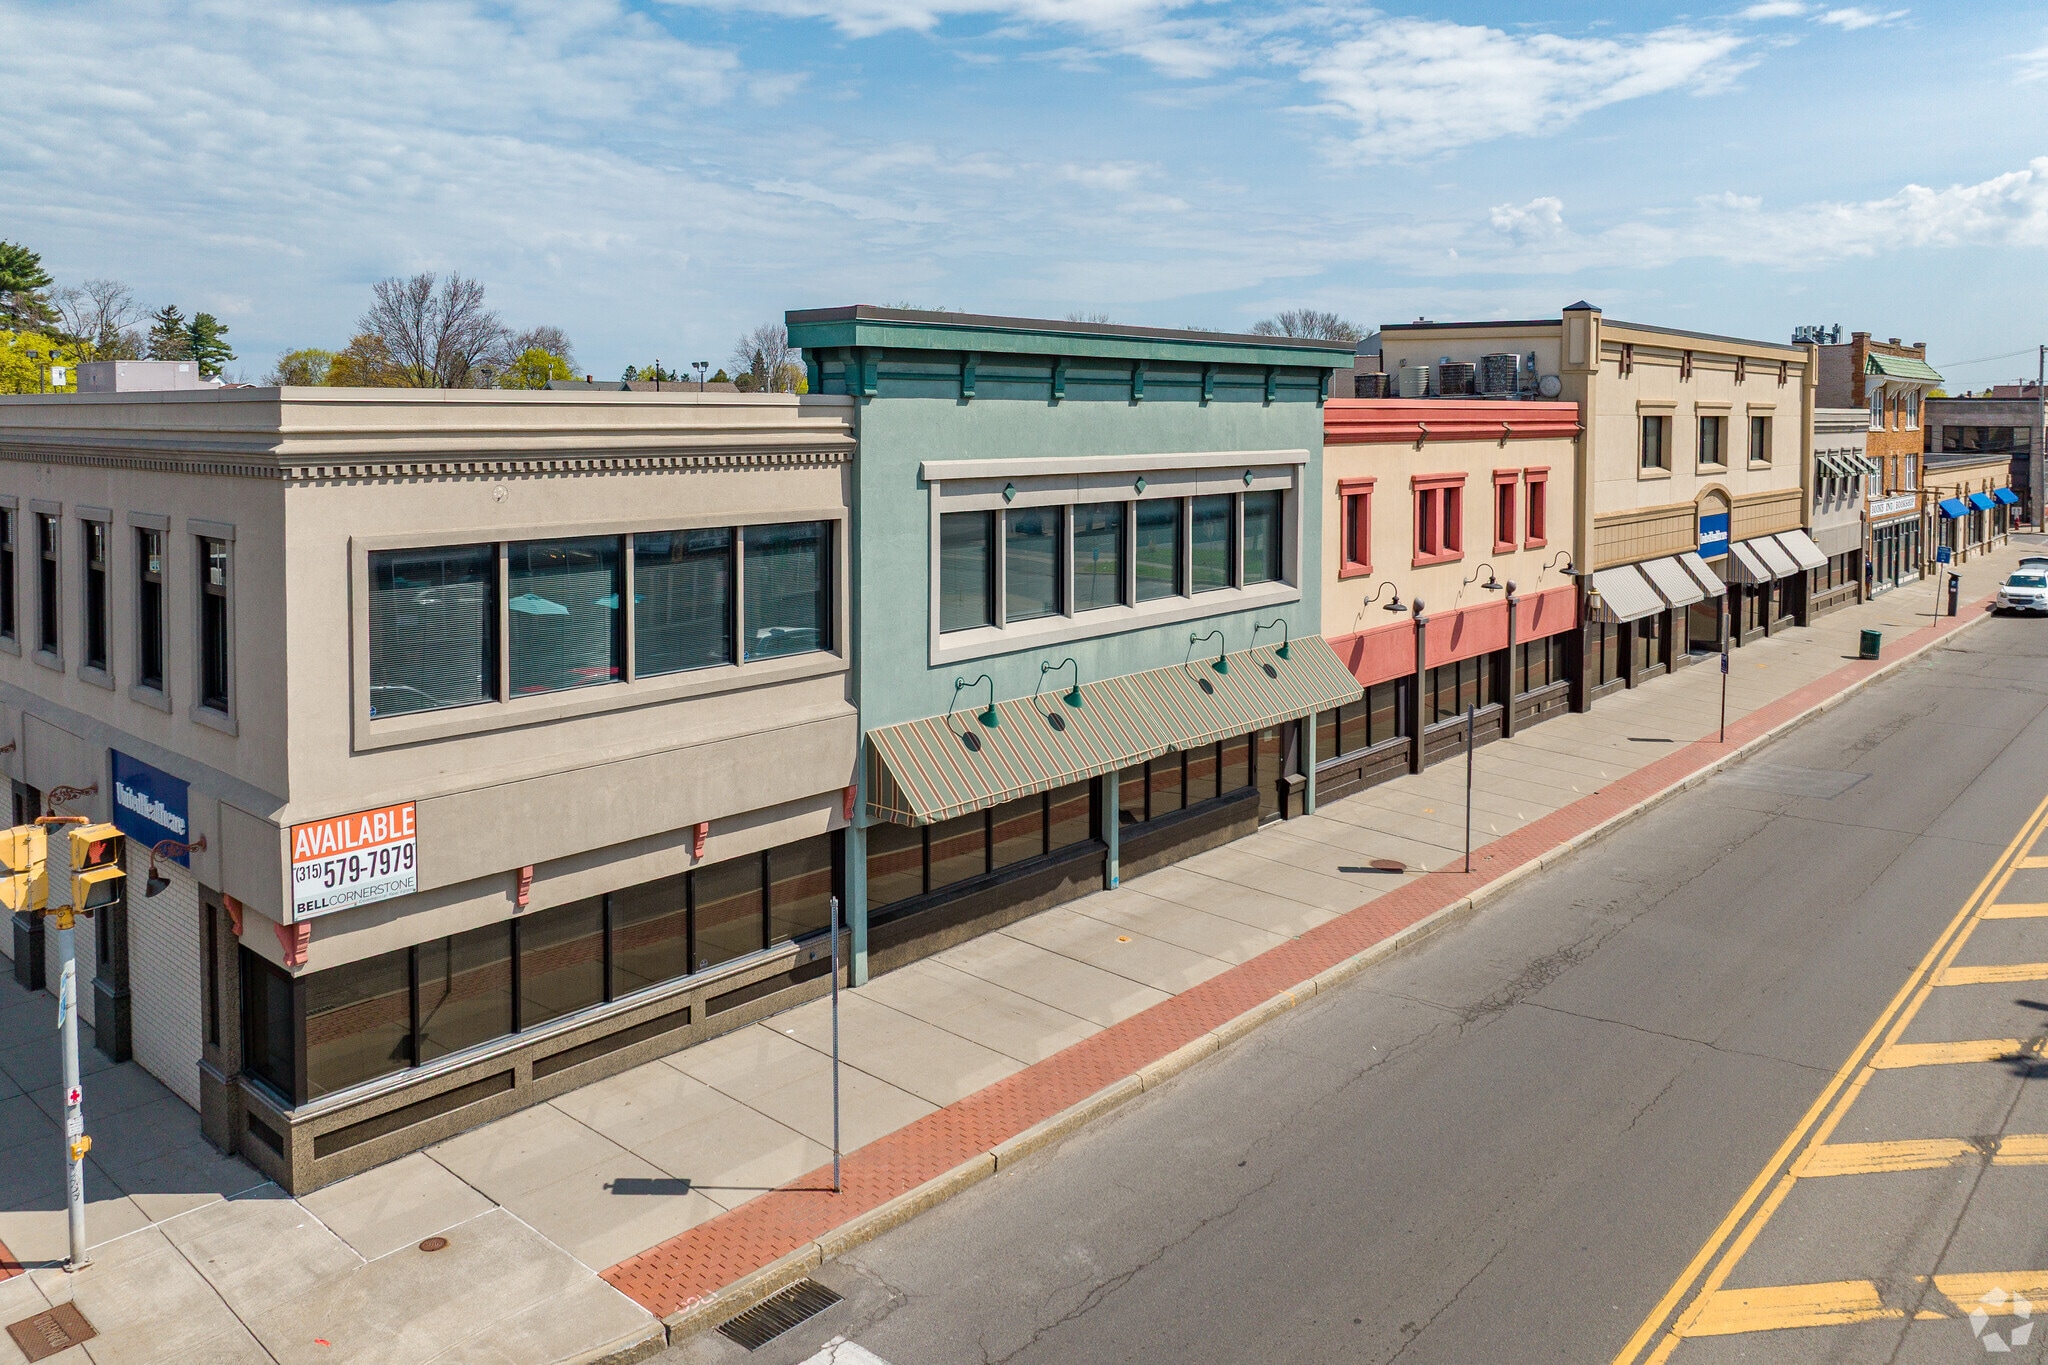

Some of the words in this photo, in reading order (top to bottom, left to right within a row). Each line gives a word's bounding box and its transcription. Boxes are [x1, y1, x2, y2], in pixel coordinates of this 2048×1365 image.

[115, 781, 186, 835] UnitedHealthcare
[294, 806, 415, 859] AVAILABLE
[295, 863, 322, 883] (315)
[324, 843, 414, 888] 579-7979
